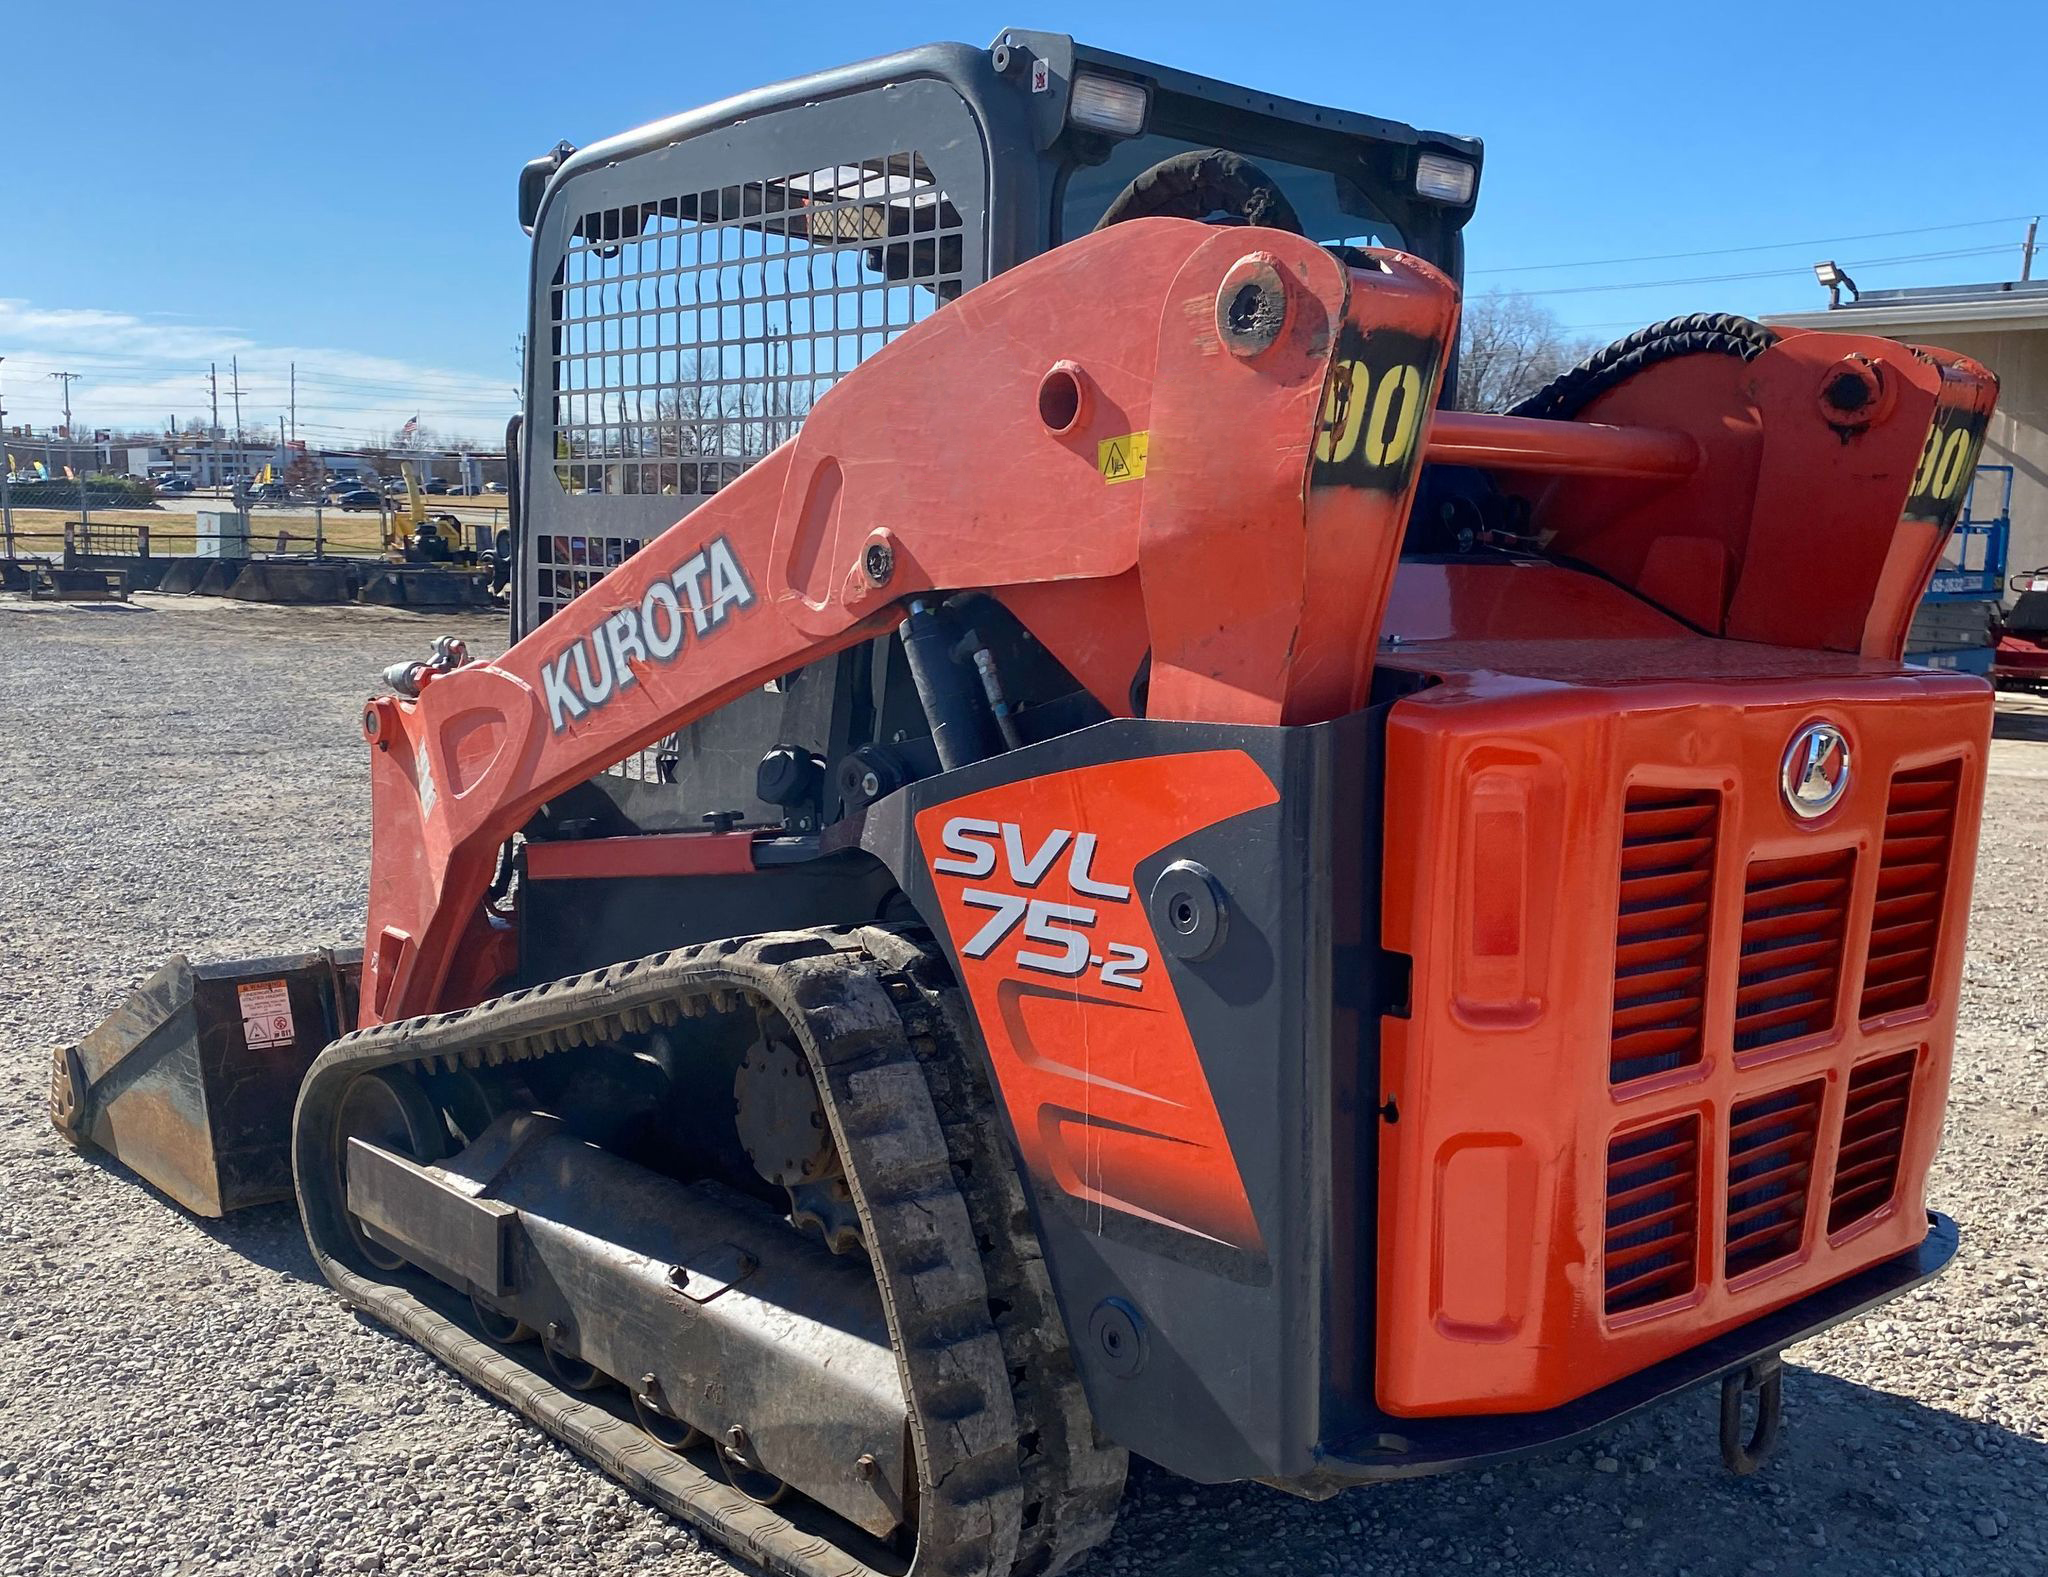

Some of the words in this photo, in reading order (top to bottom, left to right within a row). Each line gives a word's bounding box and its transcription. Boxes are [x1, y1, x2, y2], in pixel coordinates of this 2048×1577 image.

[540, 536, 753, 732] KUBOTA
[934, 816, 1131, 903] SVL
[960, 887, 1149, 991] 75-2
